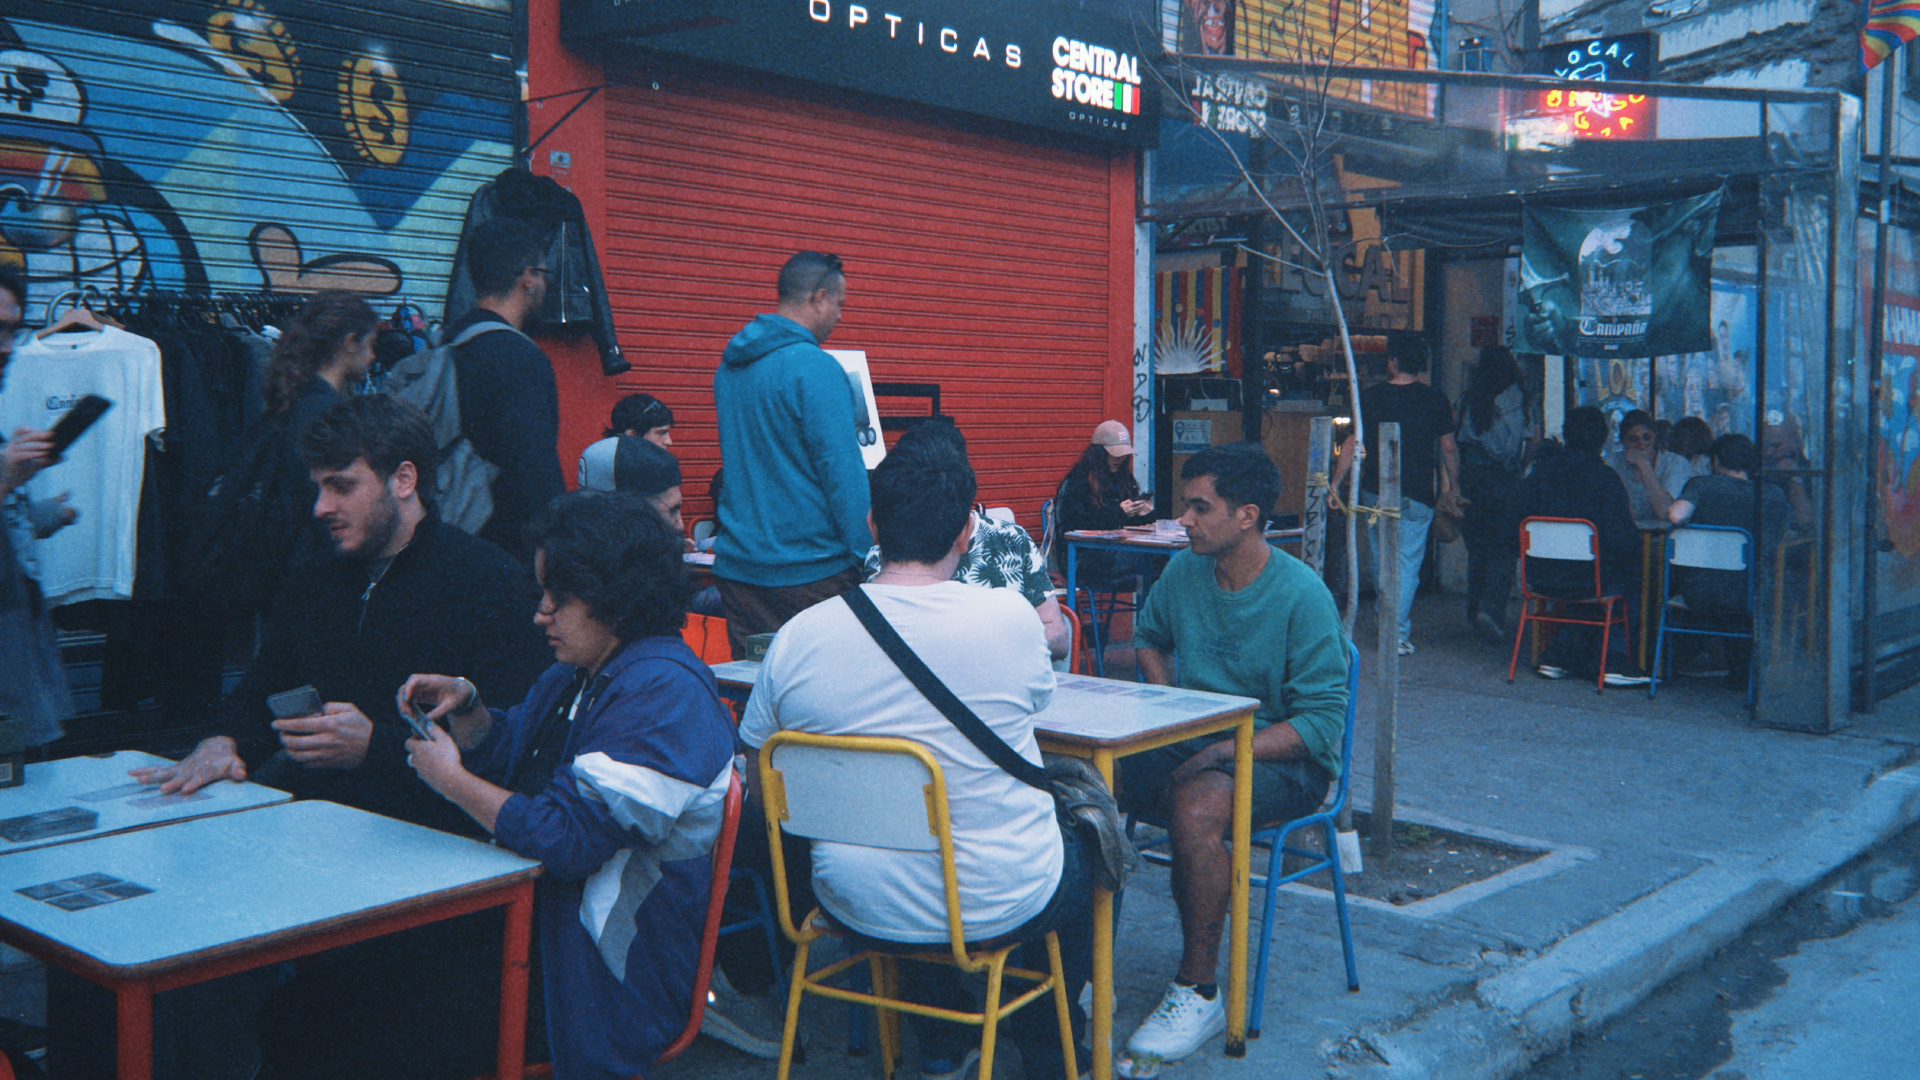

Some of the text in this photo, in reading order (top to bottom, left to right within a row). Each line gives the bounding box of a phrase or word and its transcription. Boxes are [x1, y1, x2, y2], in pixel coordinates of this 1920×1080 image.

[809, 0, 1022, 68] OPTICAS
[1052, 35, 1142, 85] CENTRAL
[1553, 40, 1635, 78] LOCAL
[1051, 67, 1114, 110] STORE
[1069, 110, 1127, 131] OPTICAS
[1281, 229, 1417, 303] LOCAL
